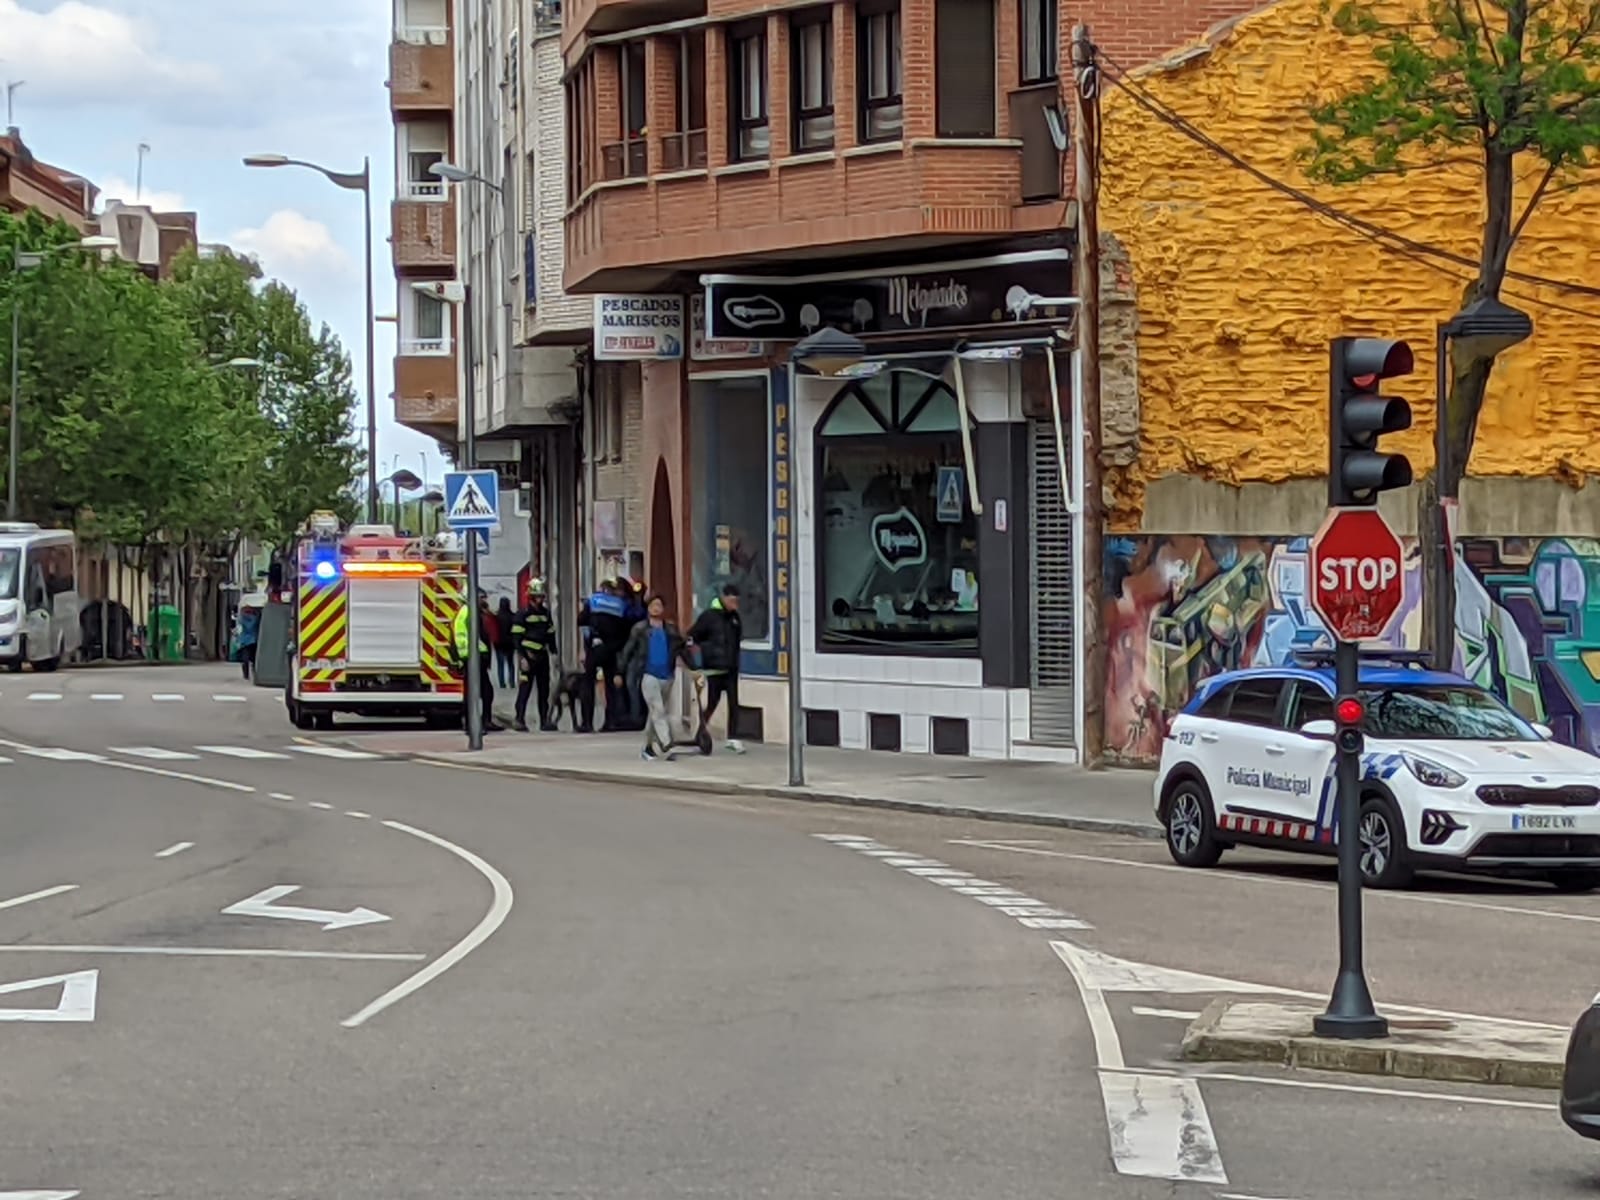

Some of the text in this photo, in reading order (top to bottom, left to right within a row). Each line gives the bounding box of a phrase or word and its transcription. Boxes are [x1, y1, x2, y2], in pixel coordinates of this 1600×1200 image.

[602, 299, 681, 312] PESCADOS
[889, 276, 968, 328] Melquiades
[602, 314, 681, 328] MARISCOS
[1320, 557, 1397, 591] STOP
[1262, 770, 1311, 796] Municipal
